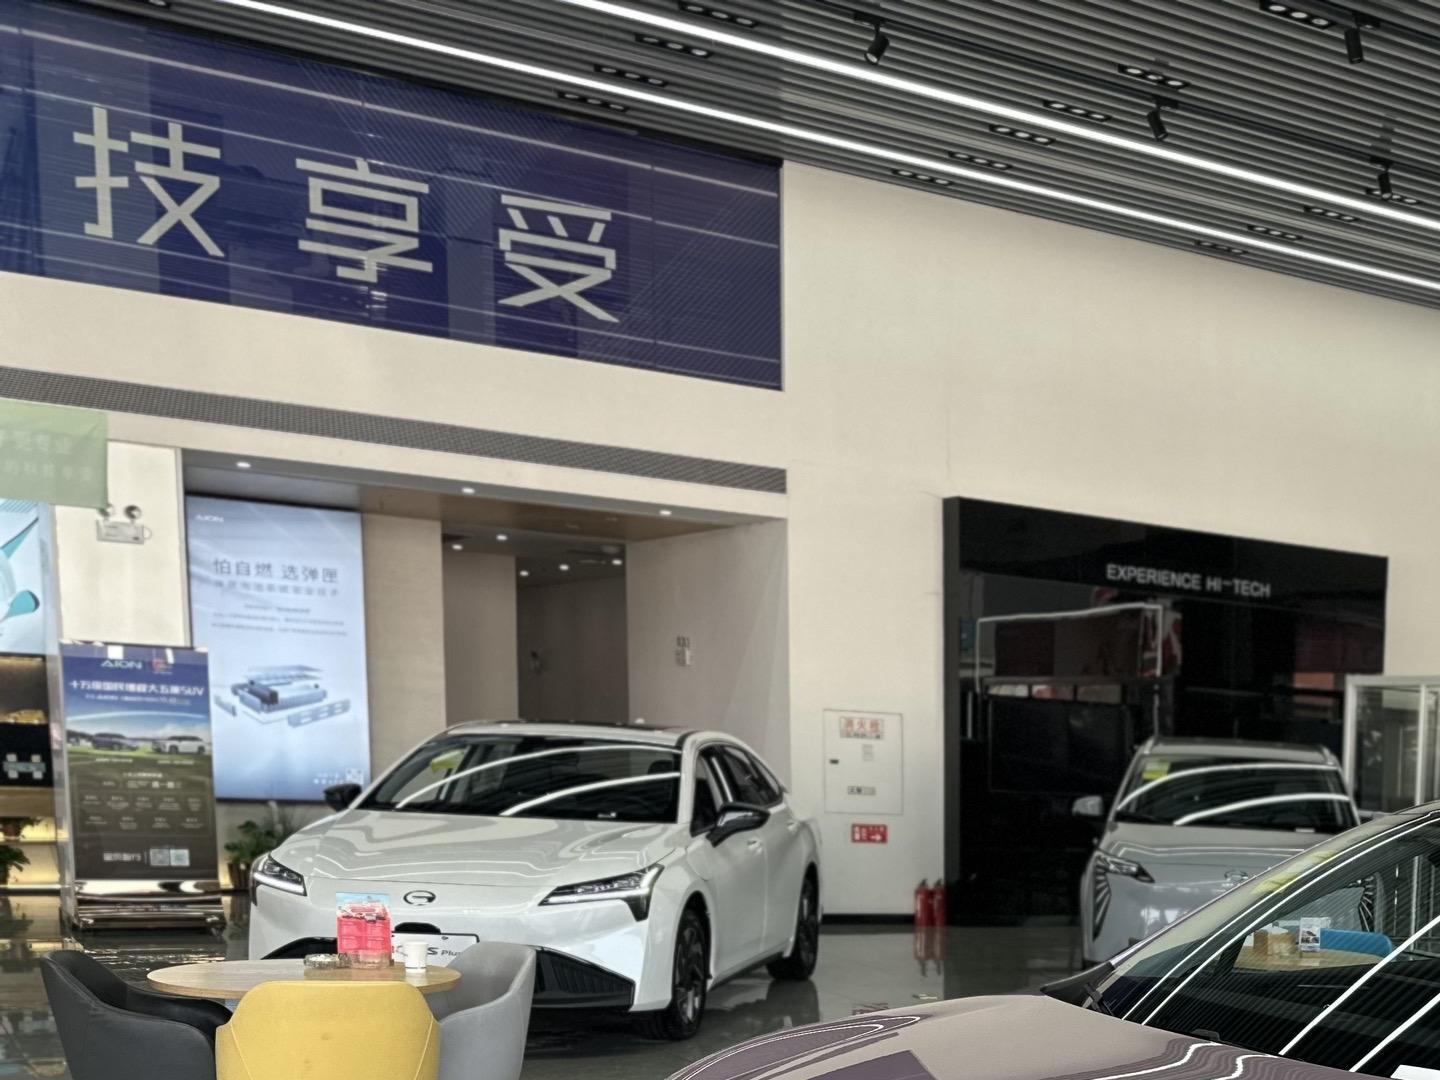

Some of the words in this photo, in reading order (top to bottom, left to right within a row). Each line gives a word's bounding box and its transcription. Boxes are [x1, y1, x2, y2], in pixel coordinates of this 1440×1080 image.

[73, 107, 620, 323] 技享受
[214, 558, 272, 578] 怕自燃
[281, 564, 338, 584] 选弹匣
[1106, 564, 1201, 590] EXPERIENCE
[1206, 576, 1271, 598] HI-TECH
[101, 660, 142, 670] AION
